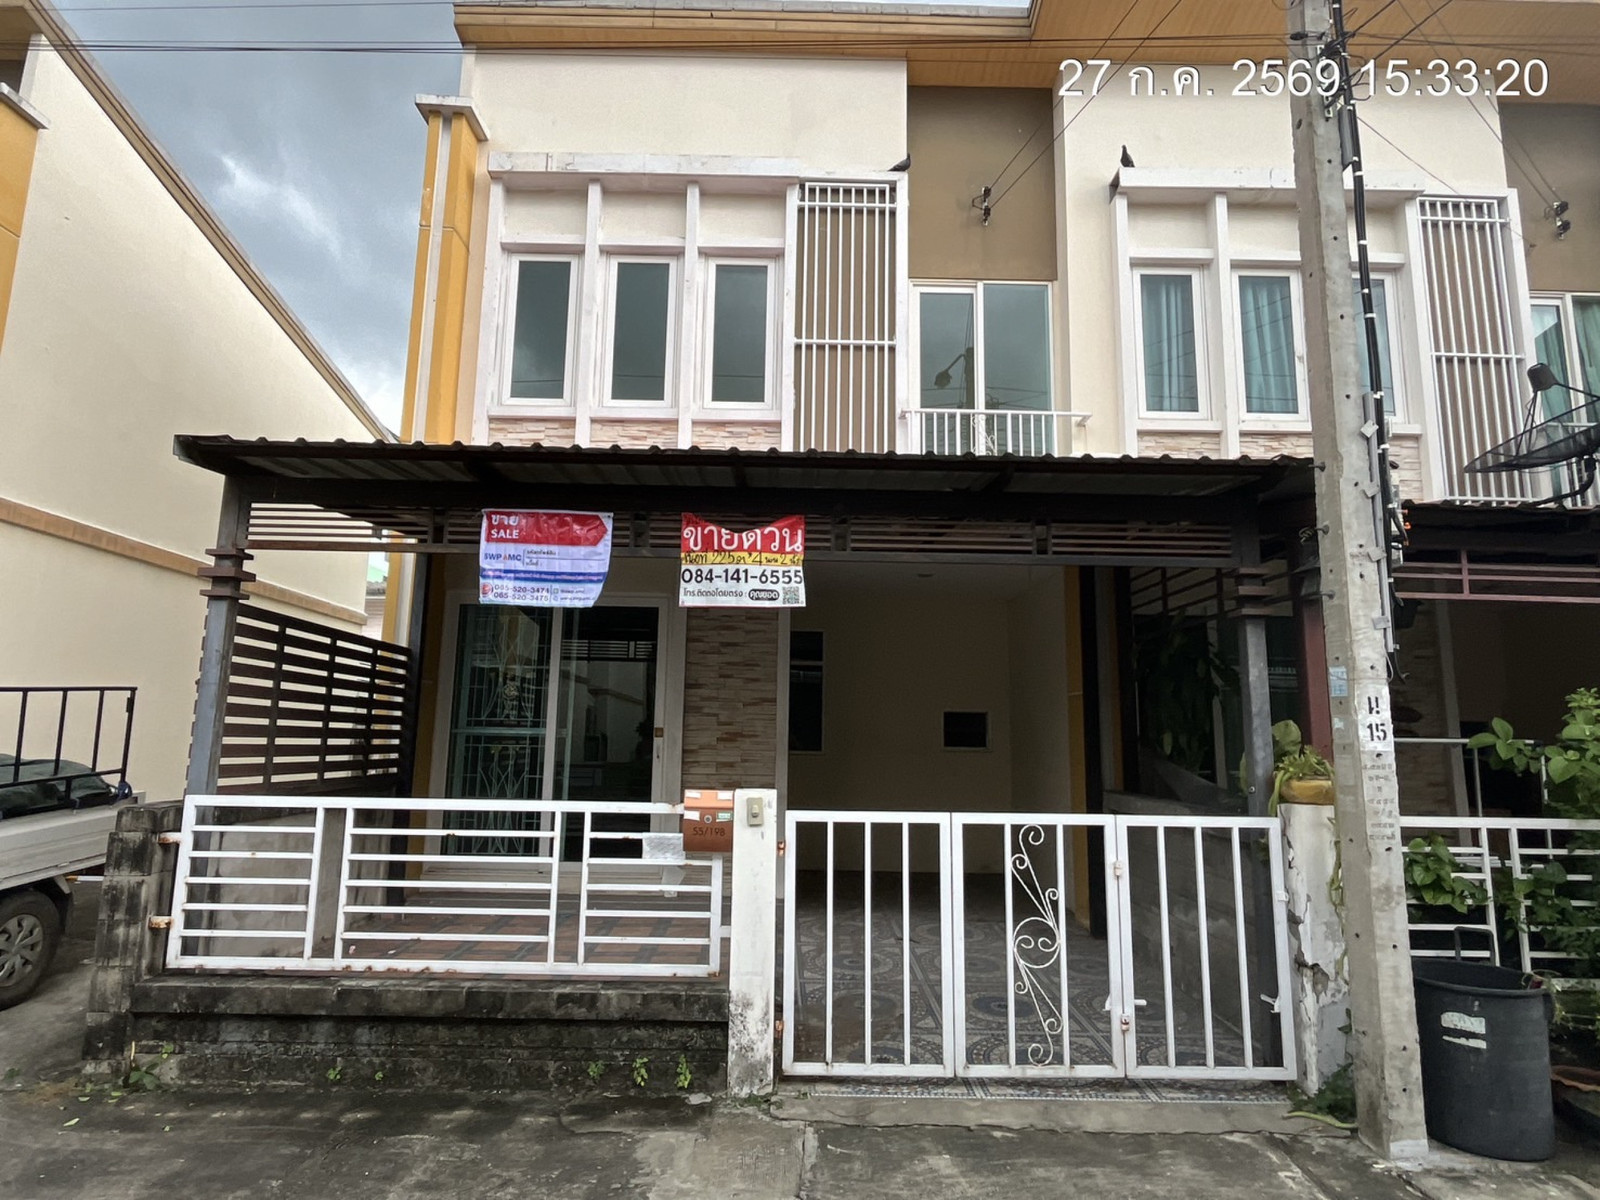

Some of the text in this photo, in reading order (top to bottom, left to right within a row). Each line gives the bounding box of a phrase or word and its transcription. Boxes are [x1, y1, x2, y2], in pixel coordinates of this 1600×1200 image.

[491, 514, 520, 526] ขาย
[491, 529, 519, 539] SALE
[780, 553, 788, 564] 2
[681, 568, 803, 585] 084-141-6555
[1367, 723, 1387, 742] 15
[692, 827, 726, 837] 55/198
